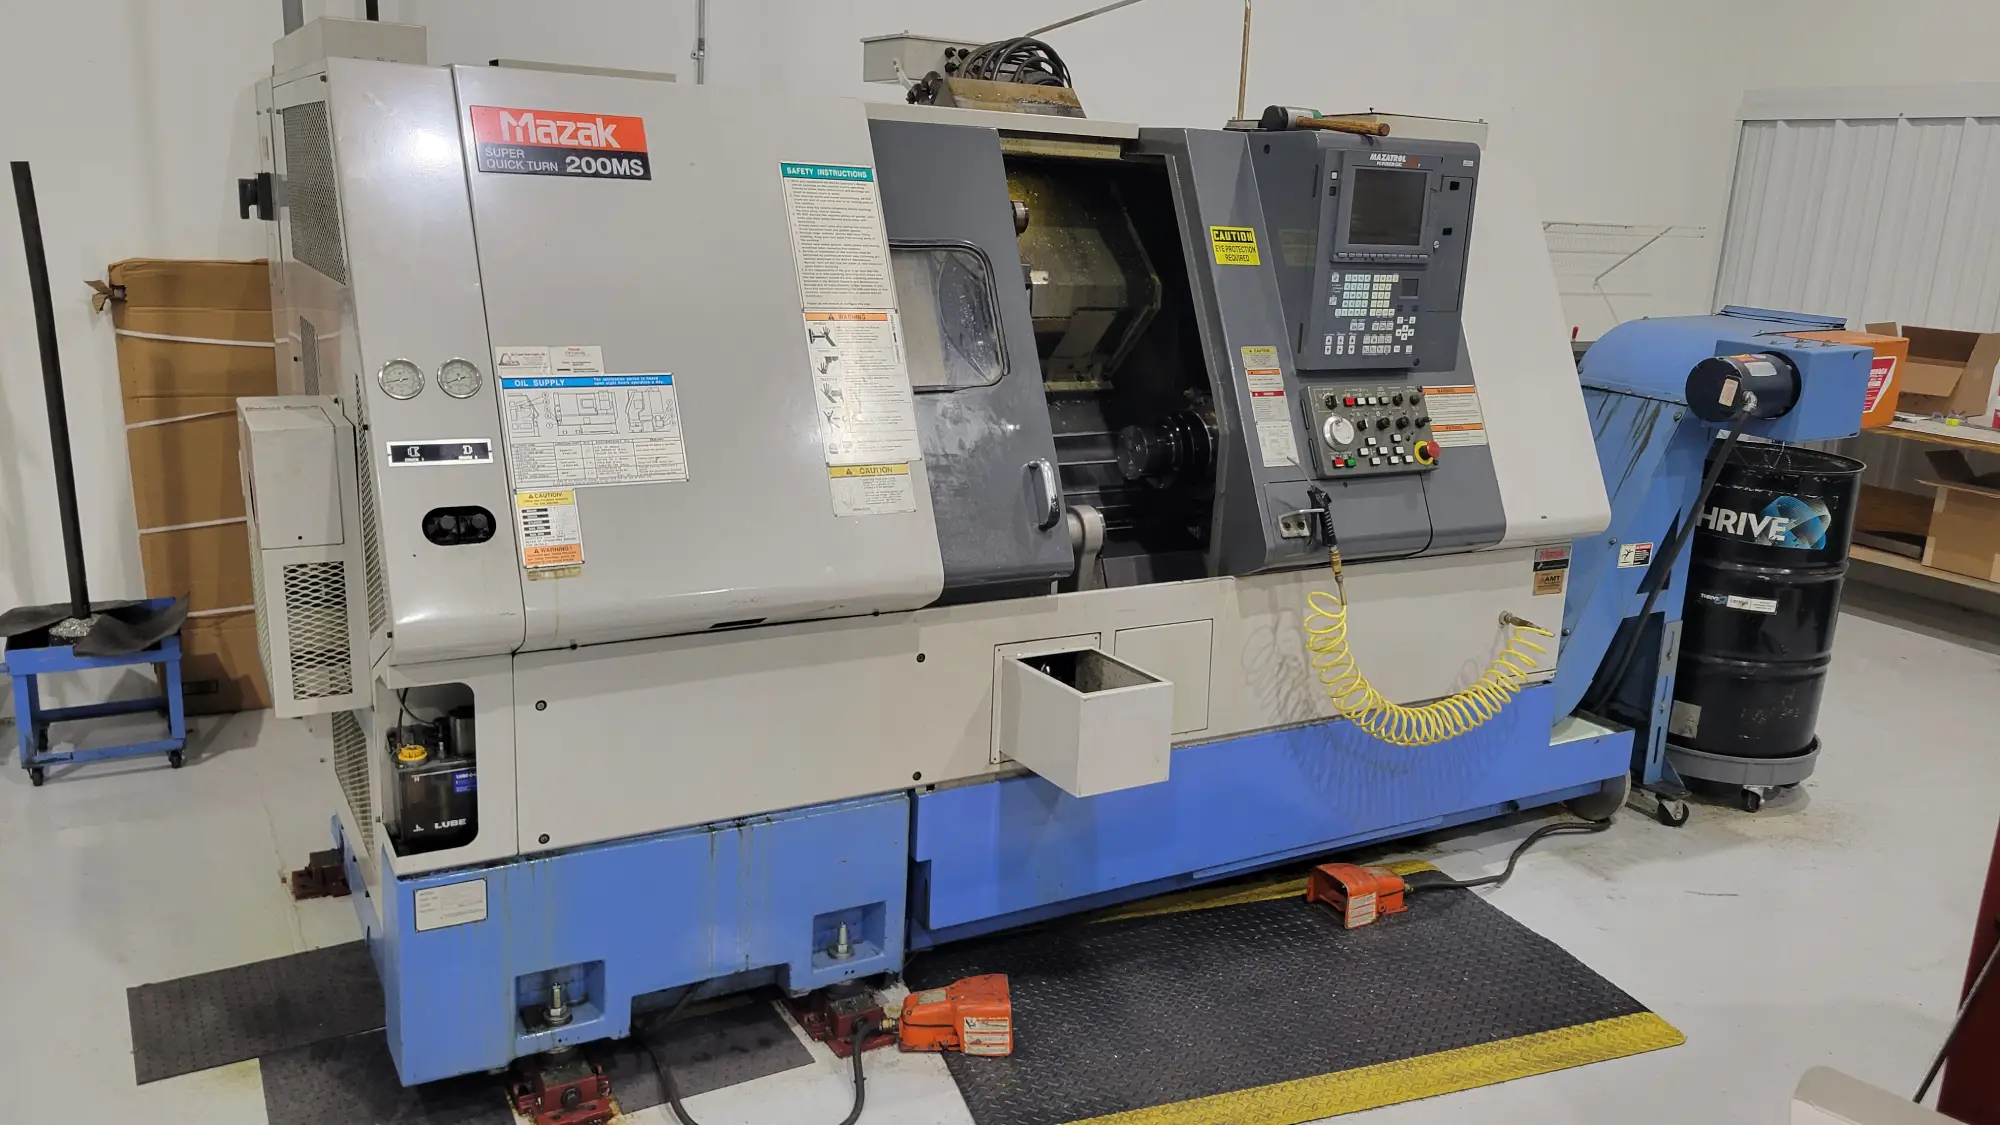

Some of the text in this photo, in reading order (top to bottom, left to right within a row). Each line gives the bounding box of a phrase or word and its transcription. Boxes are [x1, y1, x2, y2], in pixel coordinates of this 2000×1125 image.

[499, 111, 621, 149] Mazak
[485, 148, 525, 159] SUPER
[1370, 153, 1406, 163] MAZATROL
[486, 155, 644, 176] QUICK TURN 200MS
[786, 167, 867, 178] SAFETY INSTRUCTIONS
[1213, 231, 1253, 242] CAUTION
[1225, 245, 1256, 254] PROTECTION
[1225, 254, 1250, 262] REQUIRED
[514, 379, 565, 388] OIL SUPPLY
[860, 467, 893, 475] CAUTION
[1695, 506, 1790, 541] HRIVE
[434, 818, 467, 829] LUBE
